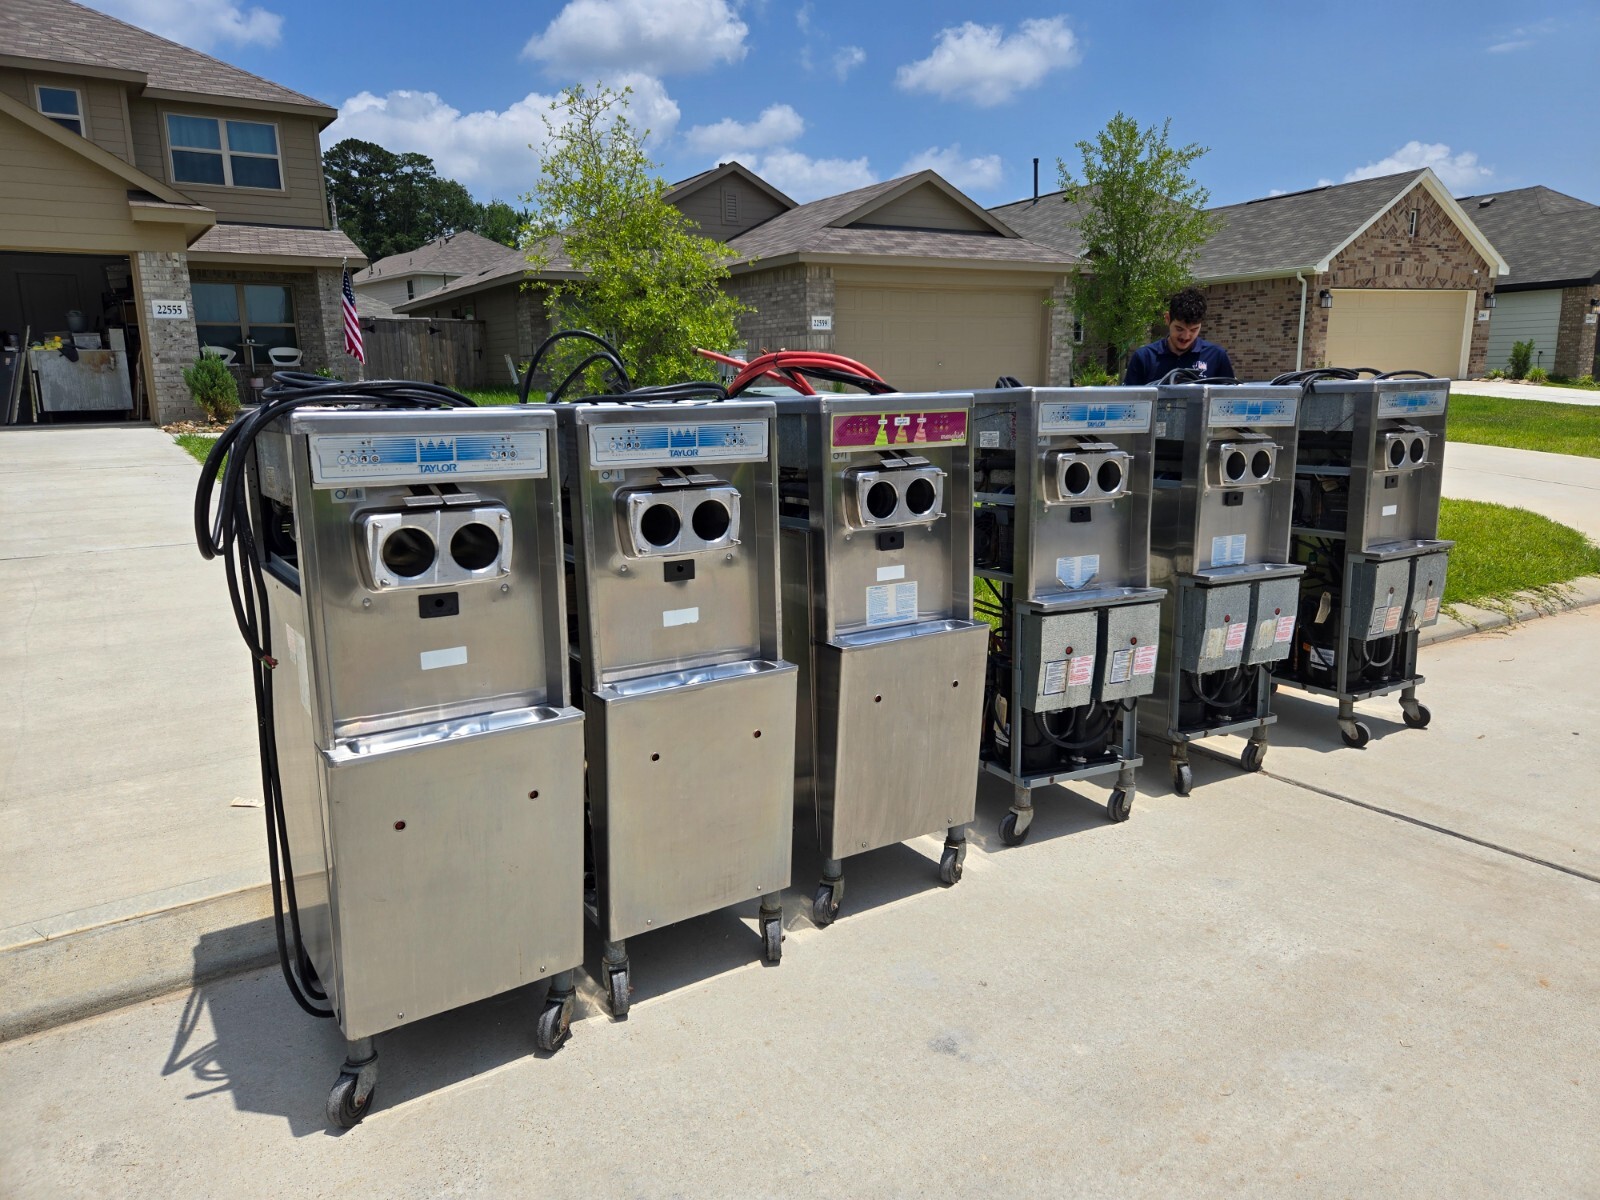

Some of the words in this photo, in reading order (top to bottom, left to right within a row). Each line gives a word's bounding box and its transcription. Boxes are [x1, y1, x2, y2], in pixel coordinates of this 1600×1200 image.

[157, 305, 182, 314] 22555
[669, 448, 699, 457] TAYLOR
[418, 463, 457, 473] TAYLOR
